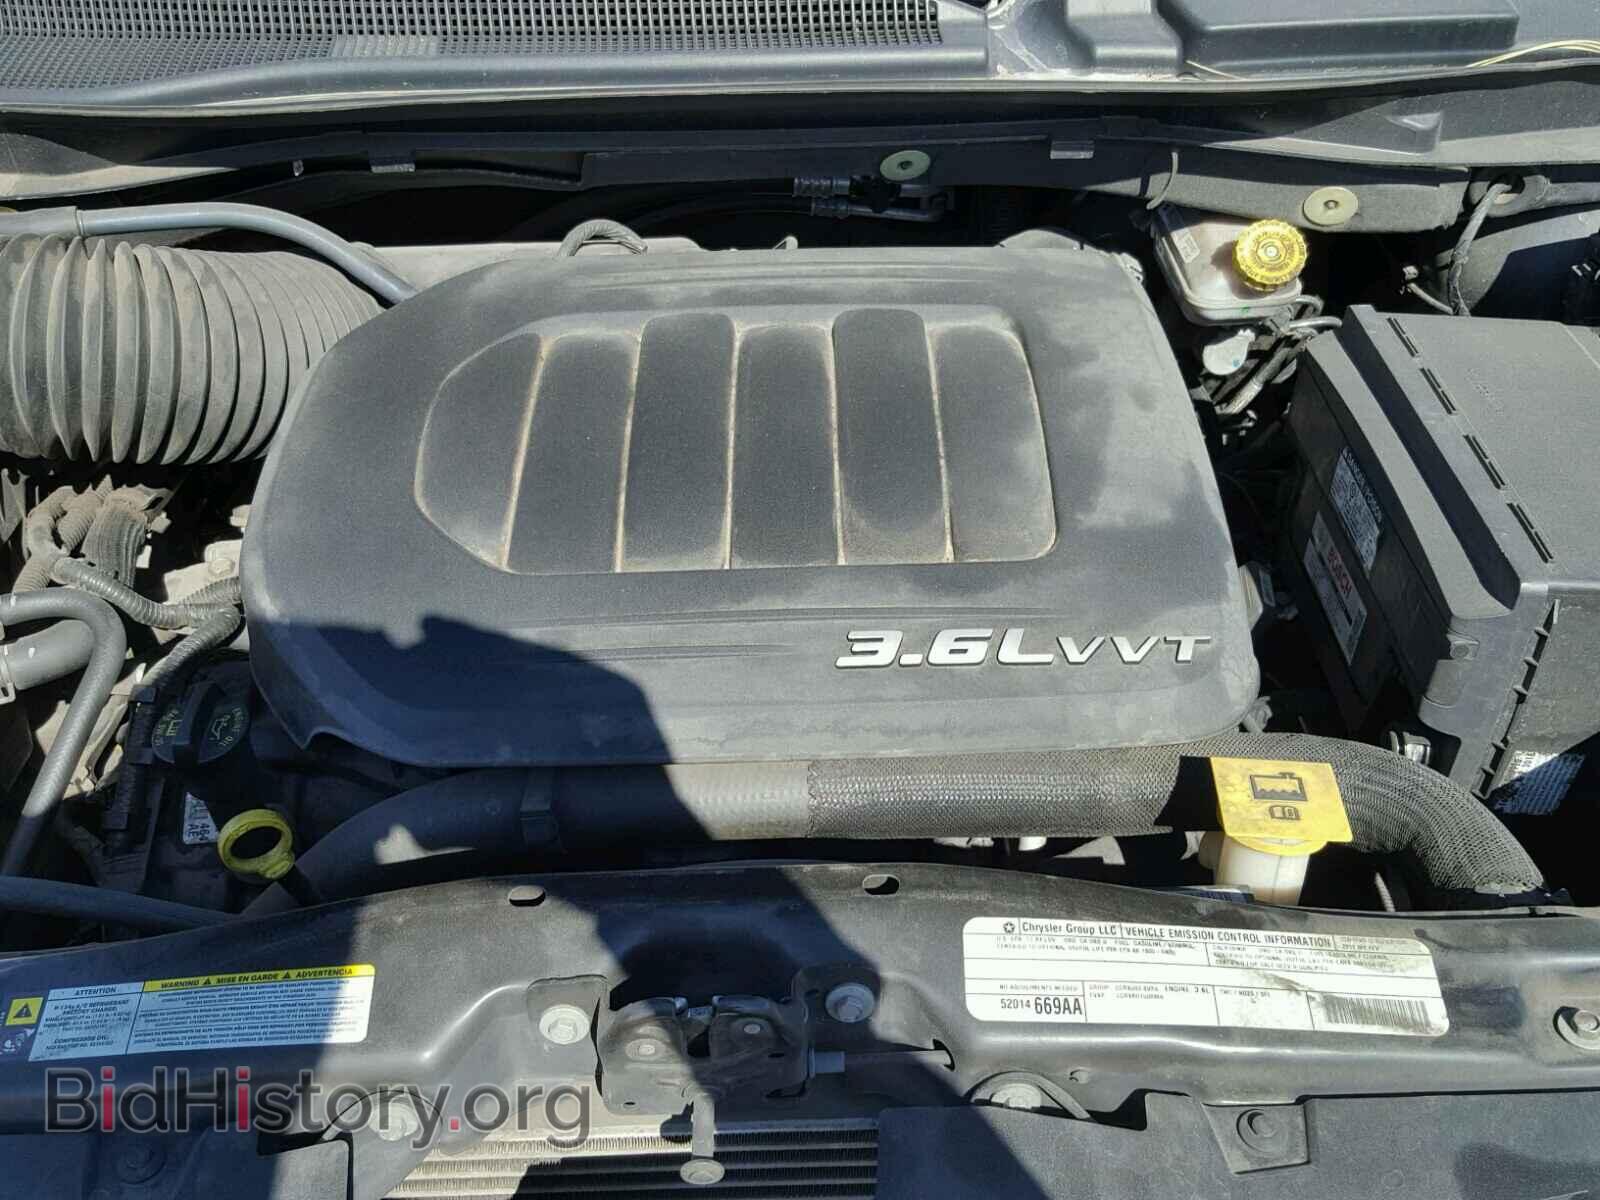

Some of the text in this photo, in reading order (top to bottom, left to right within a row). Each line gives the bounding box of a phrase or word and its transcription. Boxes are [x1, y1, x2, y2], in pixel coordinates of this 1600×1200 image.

[1022, 921, 1117, 936] Chrysler Group LLC
[1125, 926, 1166, 938] VEHICLE
[1168, 927, 1214, 941] EMISSION
[1217, 931, 1262, 944] CONTROL
[1264, 935, 1331, 948] INFORMATION
[160, 978, 200, 989] WARNING
[216, 975, 236, 985] MISE
[238, 974, 250, 983] EN
[250, 972, 280, 982] GARDE
[295, 967, 353, 979] ADVERTENCIA
[74, 986, 118, 997] ATTENTION
[1000, 998, 1031, 1010] 52014
[1034, 996, 1083, 1015] 669AA
